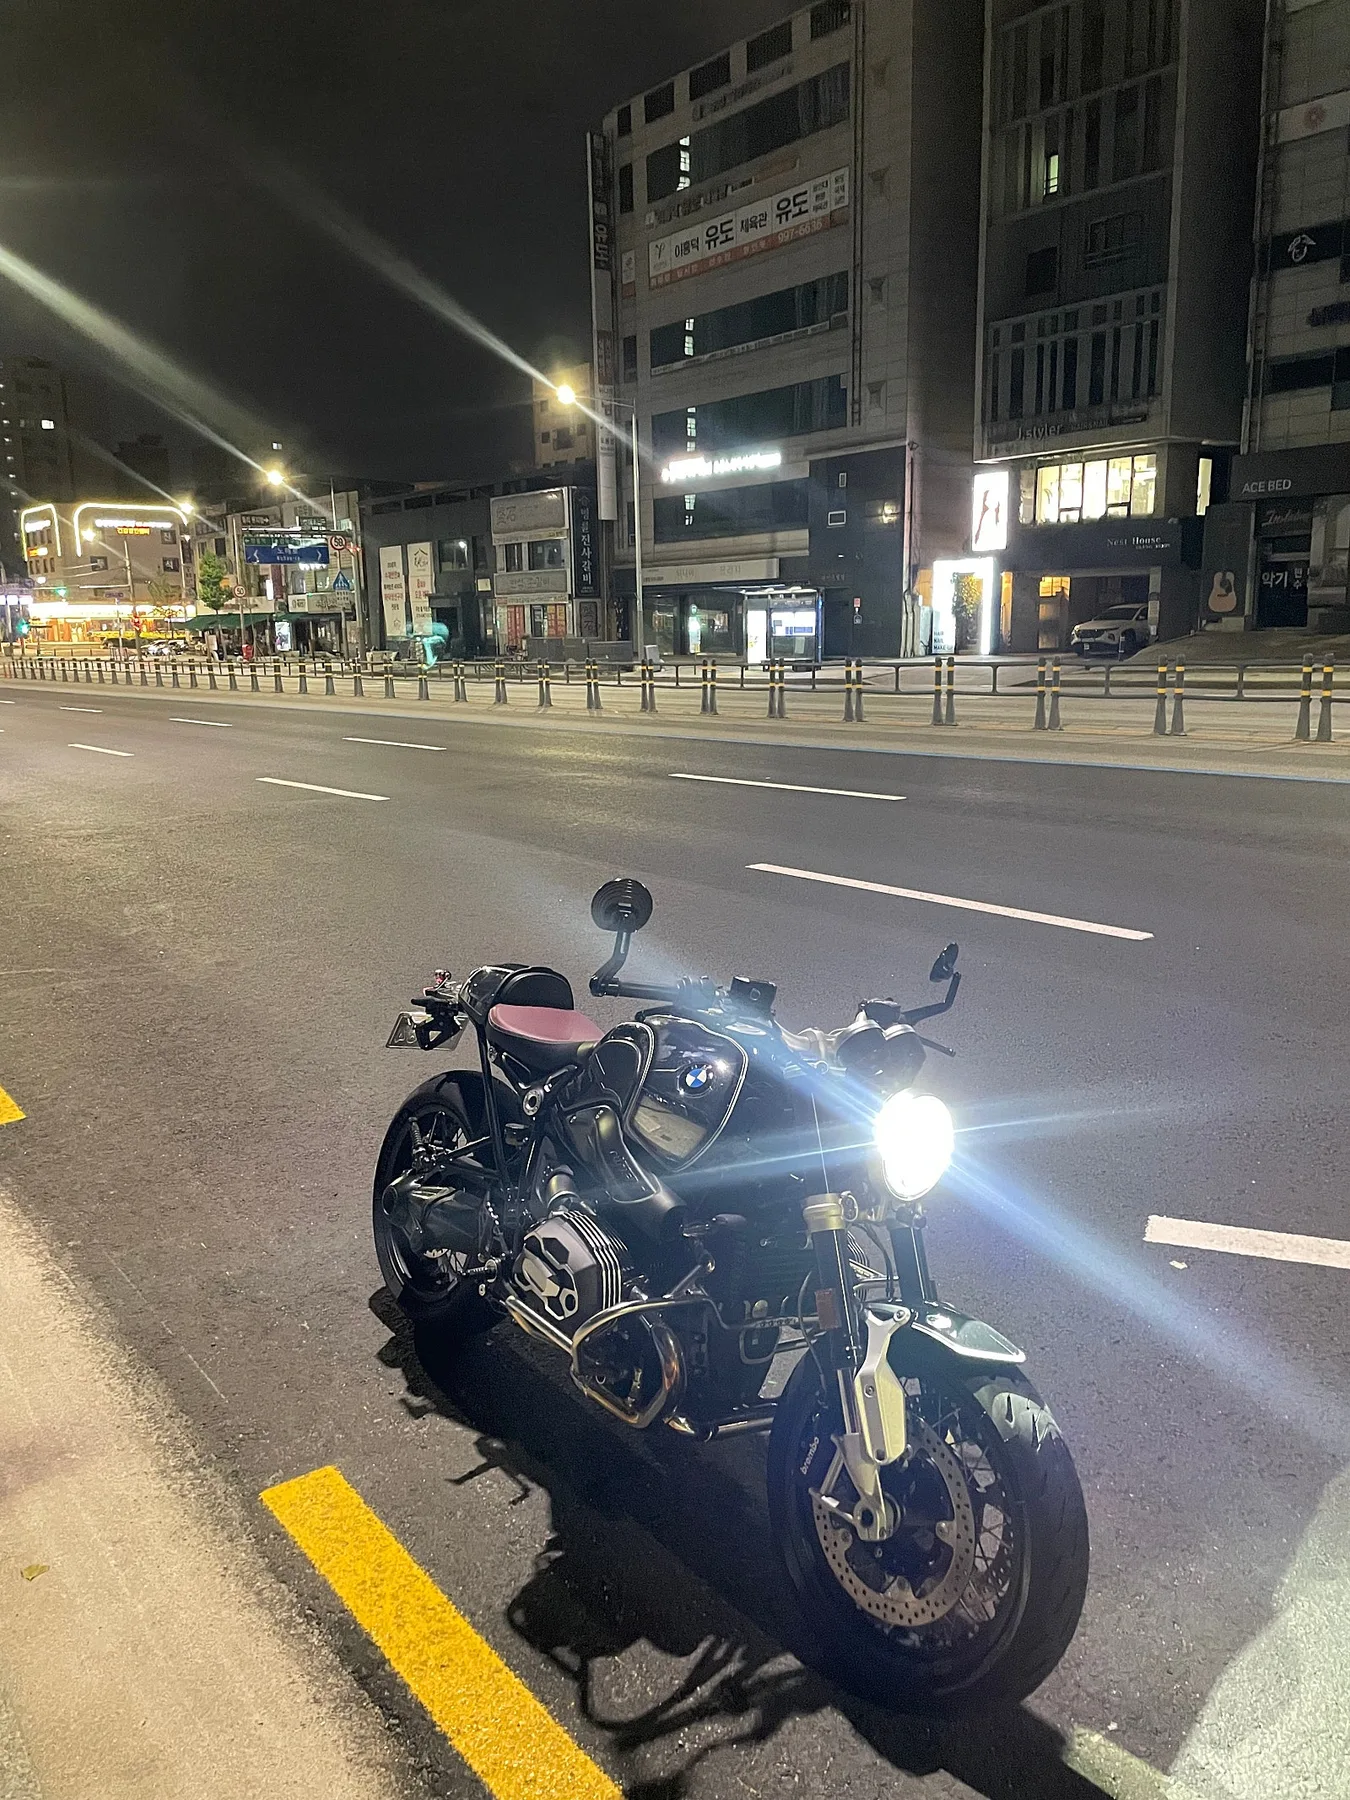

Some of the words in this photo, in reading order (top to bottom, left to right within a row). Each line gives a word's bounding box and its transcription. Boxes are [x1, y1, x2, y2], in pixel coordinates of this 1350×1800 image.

[705, 219, 735, 250] 유도
[740, 211, 768, 233] 체육관
[775, 190, 809, 225] 유도
[1241, 481, 1265, 494] ACE
[1267, 479, 1291, 492] BED
[1262, 571, 1288, 588] 악기
[800, 1436, 820, 1475] brembo
